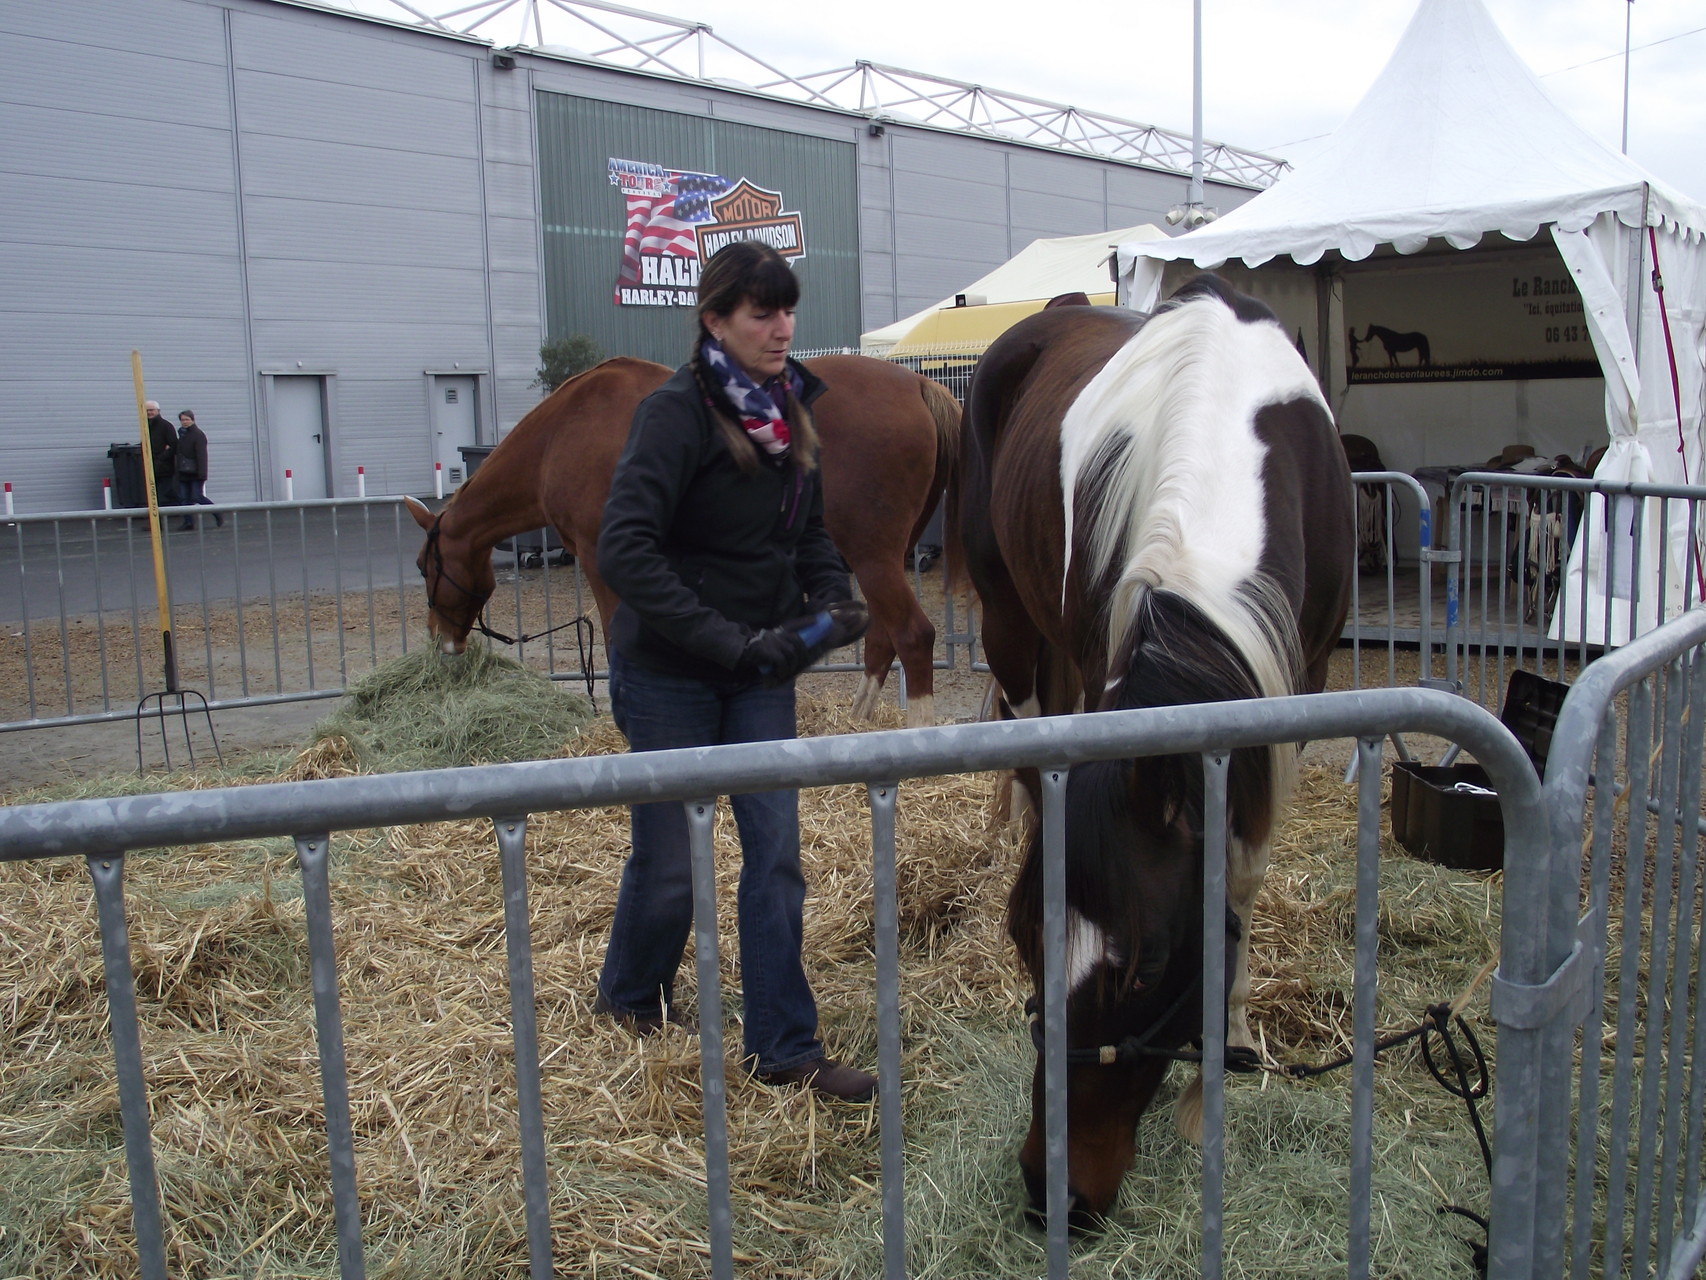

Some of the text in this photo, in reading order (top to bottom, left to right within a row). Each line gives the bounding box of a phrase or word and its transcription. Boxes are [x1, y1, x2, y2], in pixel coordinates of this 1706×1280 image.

[619, 173, 654, 190] TOUR
[723, 192, 772, 223] MOTOR
[1512, 278, 1528, 298] Le
[1545, 326, 1560, 343] 06
[1563, 325, 1578, 342] 43
